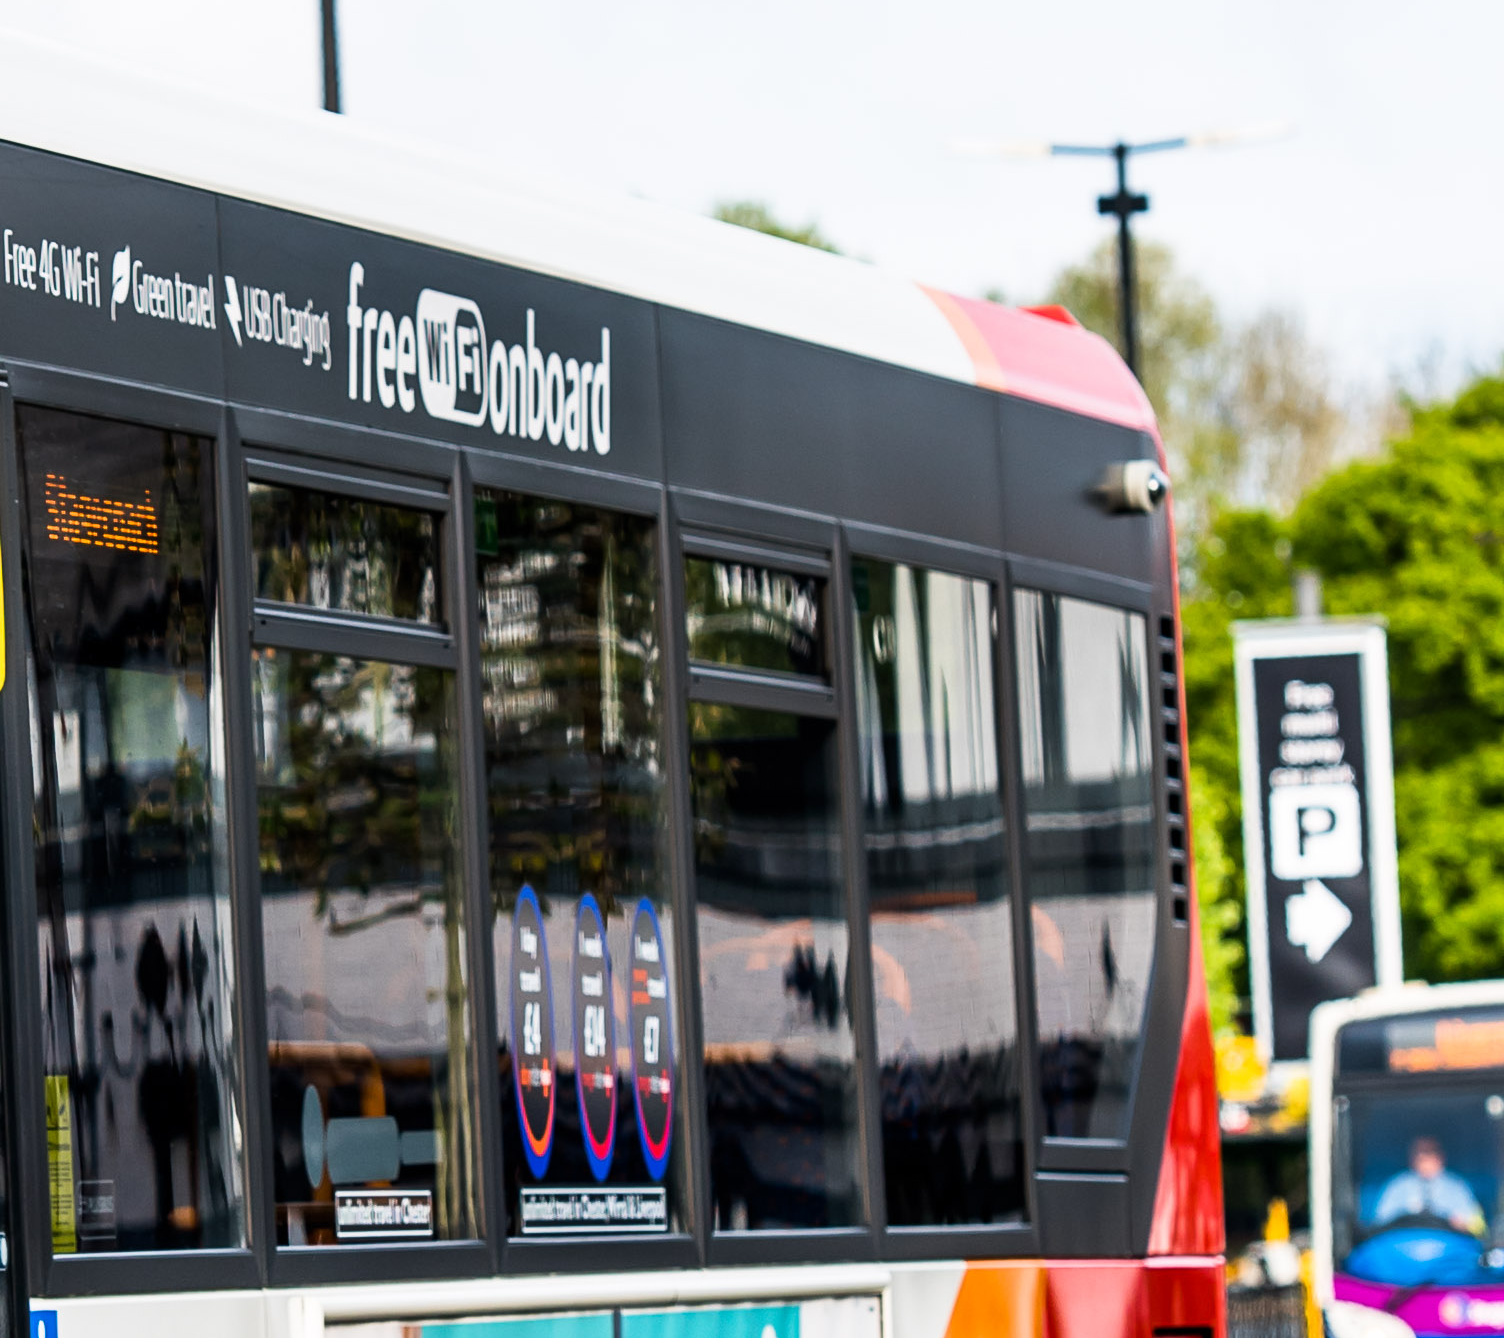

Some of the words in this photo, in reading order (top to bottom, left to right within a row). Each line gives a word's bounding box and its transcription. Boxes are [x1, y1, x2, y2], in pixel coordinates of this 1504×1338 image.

[4, 228, 37, 290] Free
[39, 239, 61, 296] 4G
[61, 245, 101, 308] Wi-Fi
[132, 260, 175, 320] Green
[175, 272, 217, 329] travel
[243, 286, 273, 342] USB
[273, 291, 332, 371] Charging
[347, 261, 417, 413] free
[490, 308, 611, 456] onboard
[1296, 806, 1337, 857] P
